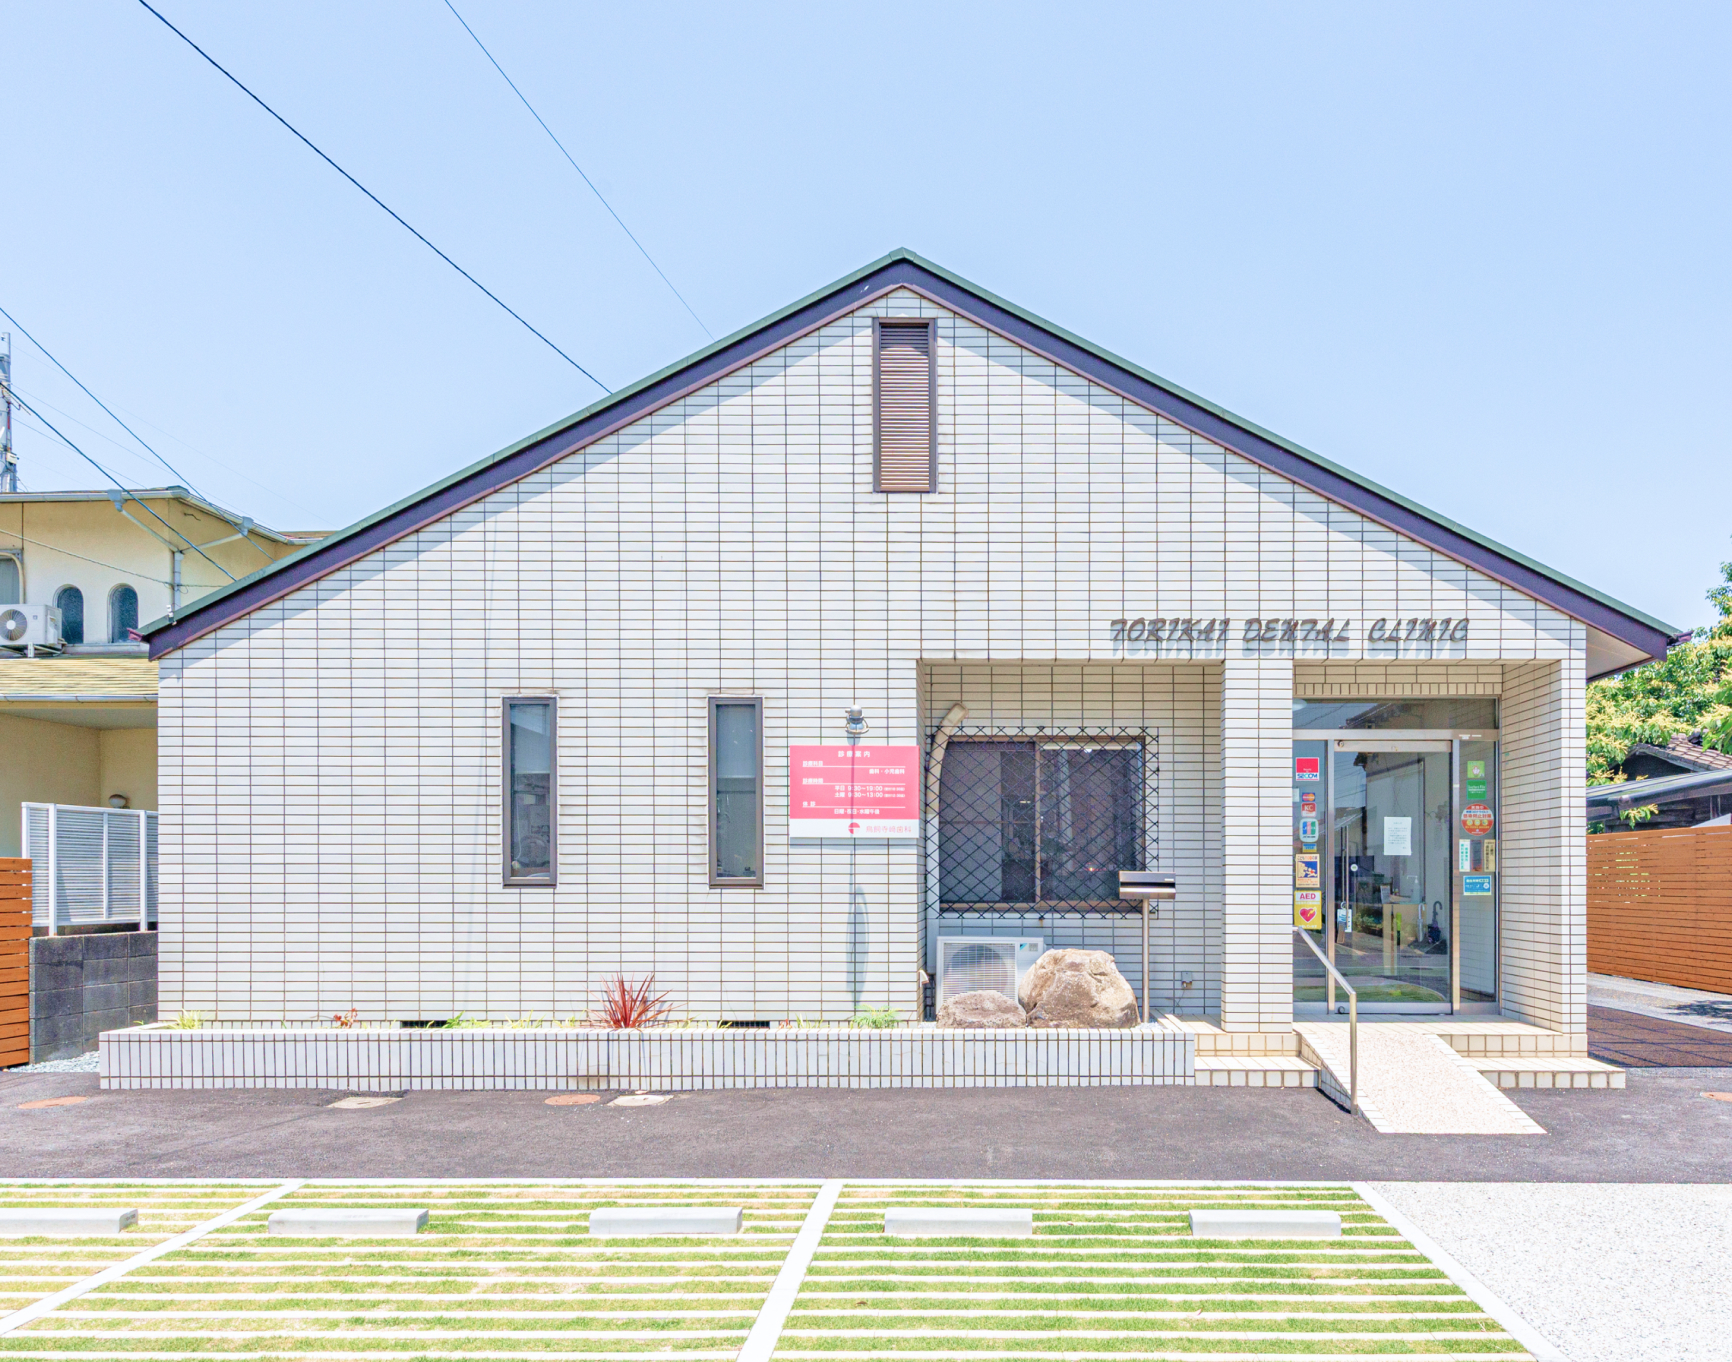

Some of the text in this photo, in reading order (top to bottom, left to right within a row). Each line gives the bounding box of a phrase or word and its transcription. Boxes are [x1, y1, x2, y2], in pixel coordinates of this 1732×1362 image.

[1110, 617, 1470, 642] TORIKAI DENTAL CLINIC
